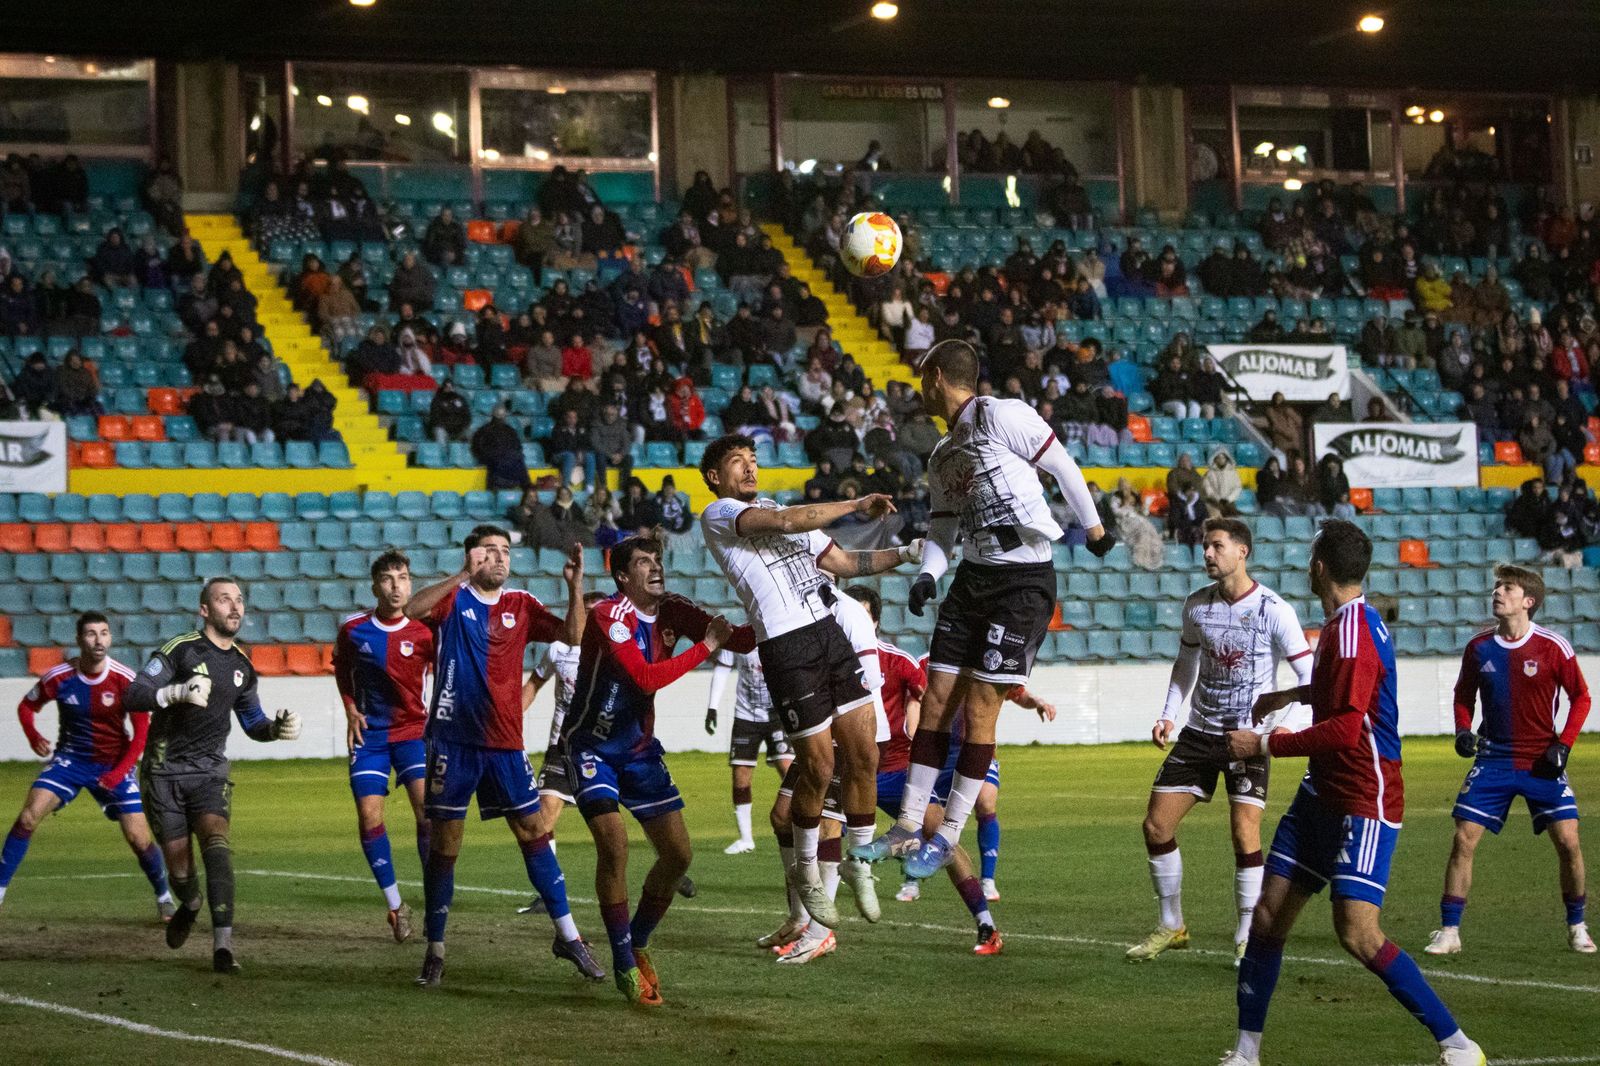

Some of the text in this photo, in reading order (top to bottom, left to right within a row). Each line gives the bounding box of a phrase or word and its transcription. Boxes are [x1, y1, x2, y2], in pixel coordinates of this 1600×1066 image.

[919, 85, 943, 99] VIDA
[1239, 353, 1317, 377] ALJOMAR
[1351, 433, 1443, 460] ALJOMAR
[436, 689, 456, 721] PJR
[787, 708, 800, 730] 9
